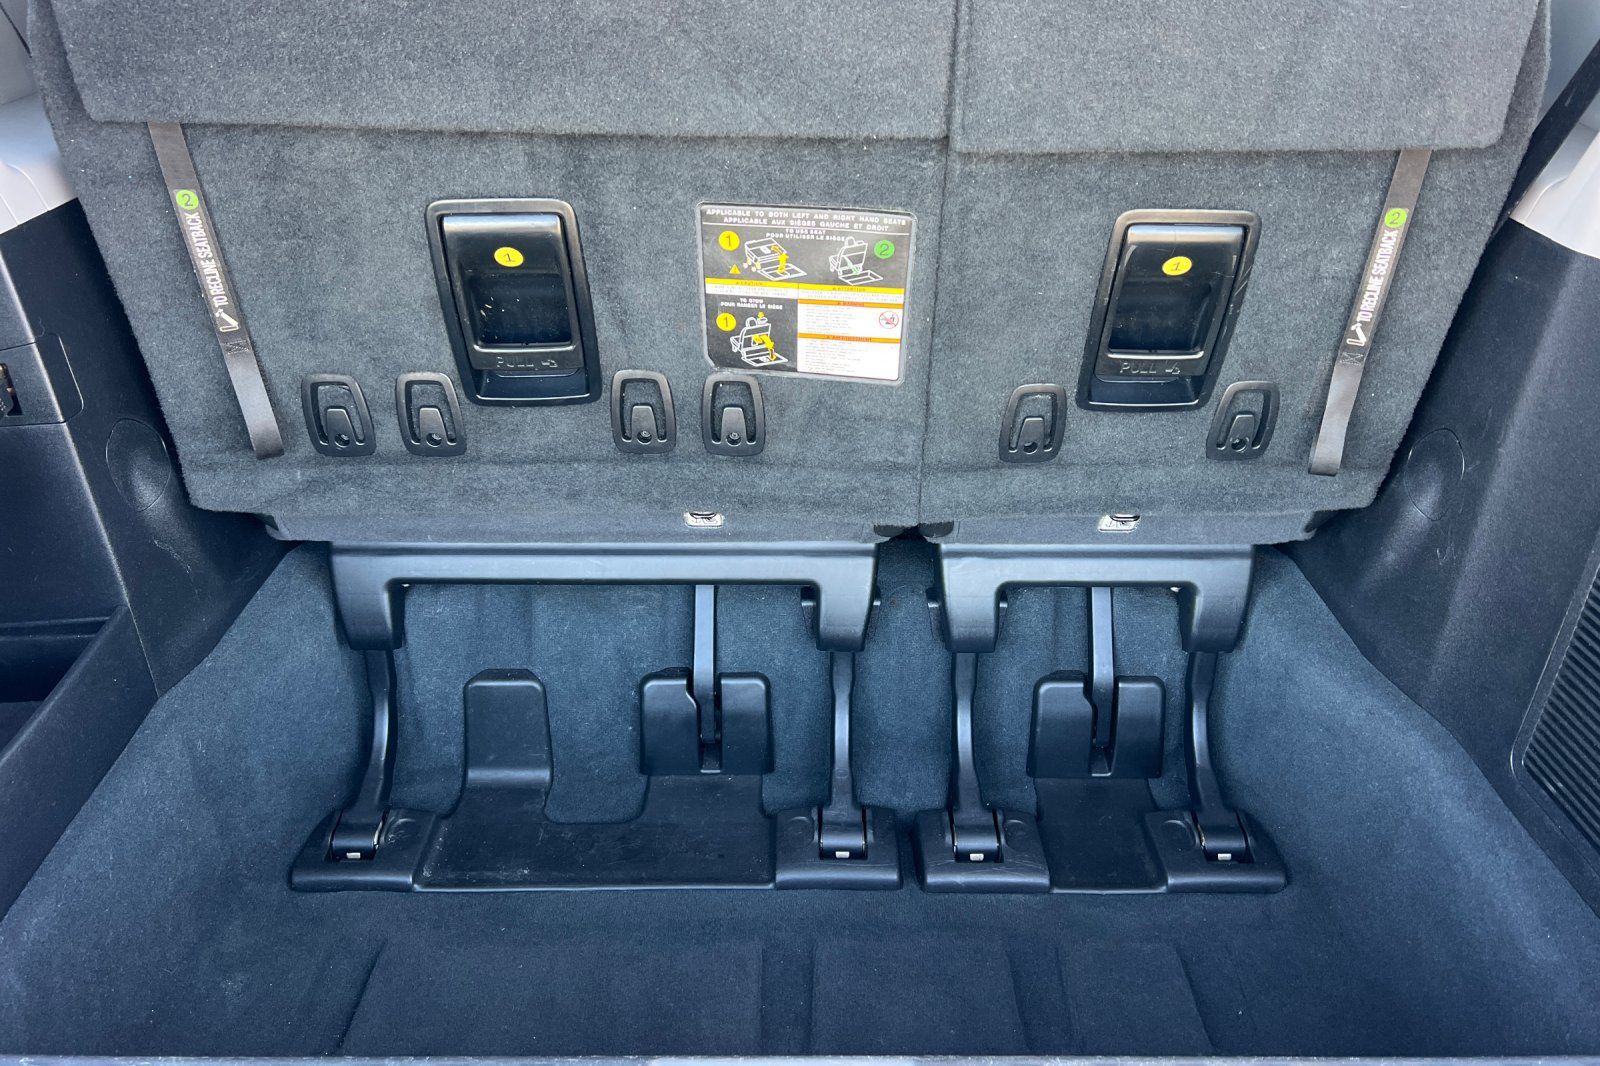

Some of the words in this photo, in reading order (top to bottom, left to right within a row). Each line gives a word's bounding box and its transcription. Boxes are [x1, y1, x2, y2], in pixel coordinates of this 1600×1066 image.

[181, 192, 194, 207] 2
[706, 208, 751, 217] APPLICABLE
[833, 214, 855, 222] RIGHT
[859, 215, 880, 223] HAND
[883, 217, 907, 226] SEATS
[723, 217, 768, 225] APPLICABLE
[819, 220, 850, 229] GAUCHE
[866, 224, 889, 232] DROIT
[1389, 211, 1401, 225] 2
[184, 211, 214, 259] SEATBACK
[879, 243, 890, 256] 2
[1371, 229, 1399, 276] SEATBACK
[201, 259, 226, 296] RECLINE
[1360, 275, 1384, 312] RECLINE
[212, 295, 229, 308] TO
[1356, 310, 1373, 323] TO
[496, 355, 535, 368] PULL
[1119, 362, 1157, 374] PULL
